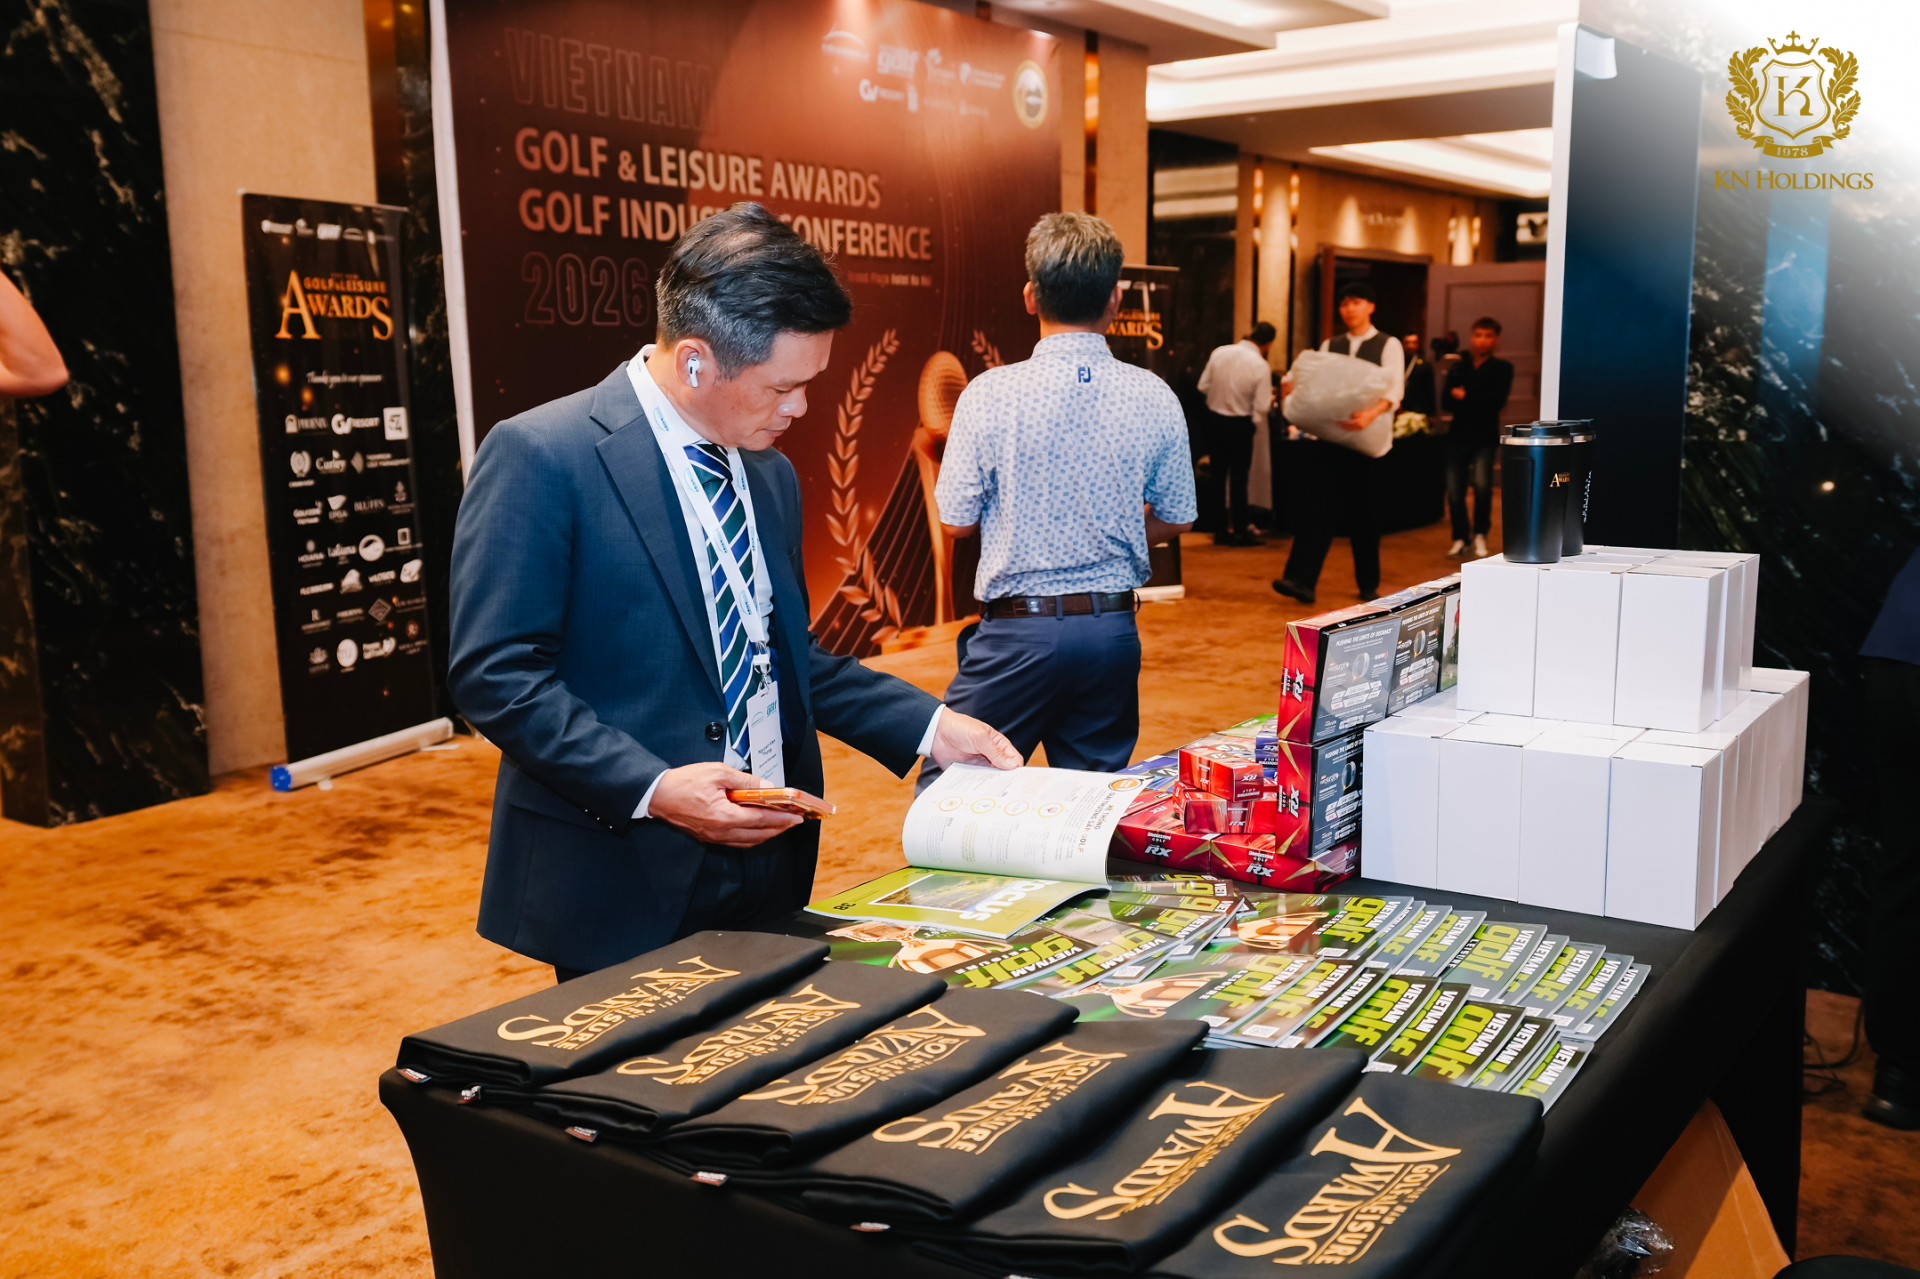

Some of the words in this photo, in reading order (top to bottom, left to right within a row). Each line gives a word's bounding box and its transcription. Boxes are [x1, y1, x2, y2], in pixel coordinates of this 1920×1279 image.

[504, 28, 719, 134] VIETNAM
[515, 127, 608, 178] GOLF
[617, 149, 637, 182] &
[643, 145, 763, 196] LEISURE
[770, 162, 881, 209] AWARDS
[518, 188, 610, 236] GOLF
[780, 213, 932, 260] ONFERENCE
[275, 269, 394, 341] AWARDS
[521, 252, 652, 326] 2026
[1078, 367, 1091, 383] FJ
[1078, 833, 1089, 853] GOLF
[1144, 844, 1173, 858] RX
[1246, 864, 1275, 877] RX
[1323, 897, 1386, 943] golf
[1364, 901, 1401, 928] VIETNAM
[1404, 911, 1439, 939] VIETNAM
[1440, 916, 1474, 946] VIETNAM
[963, 933, 1074, 989] golf
[1011, 947, 1083, 978] VIETNAM
[1100, 938, 1167, 970] VIETNAM
[1458, 924, 1519, 981] golf
[1501, 929, 1535, 963] VIETNAM
[1525, 940, 1556, 975] VIETNAM
[1211, 954, 1293, 1010] golf
[1260, 959, 1308, 991] VIETNAM
[1306, 964, 1353, 999] VIETNAM
[1556, 950, 1593, 985] VIETNAM
[1586, 960, 1621, 994] VIETNAM
[1607, 969, 1639, 1001] VIETNAM
[497, 956, 741, 1047] AWARDS
[1330, 973, 1377, 1008] VIETNAM
[1382, 983, 1426, 1024] VIETNAM
[1416, 990, 1458, 1033] VIETNAM
[616, 983, 861, 1085] AWARDS
[737, 1004, 987, 1105] AWARDS
[1466, 1012, 1512, 1057] VIETNAM
[1495, 1023, 1541, 1065] VIETNAM
[1537, 1044, 1579, 1086] VIETNAM
[872, 1042, 1128, 1148] AWARDS
[1043, 1080, 1286, 1220] AWARDS
[1213, 1097, 1462, 1265] AWARDS
